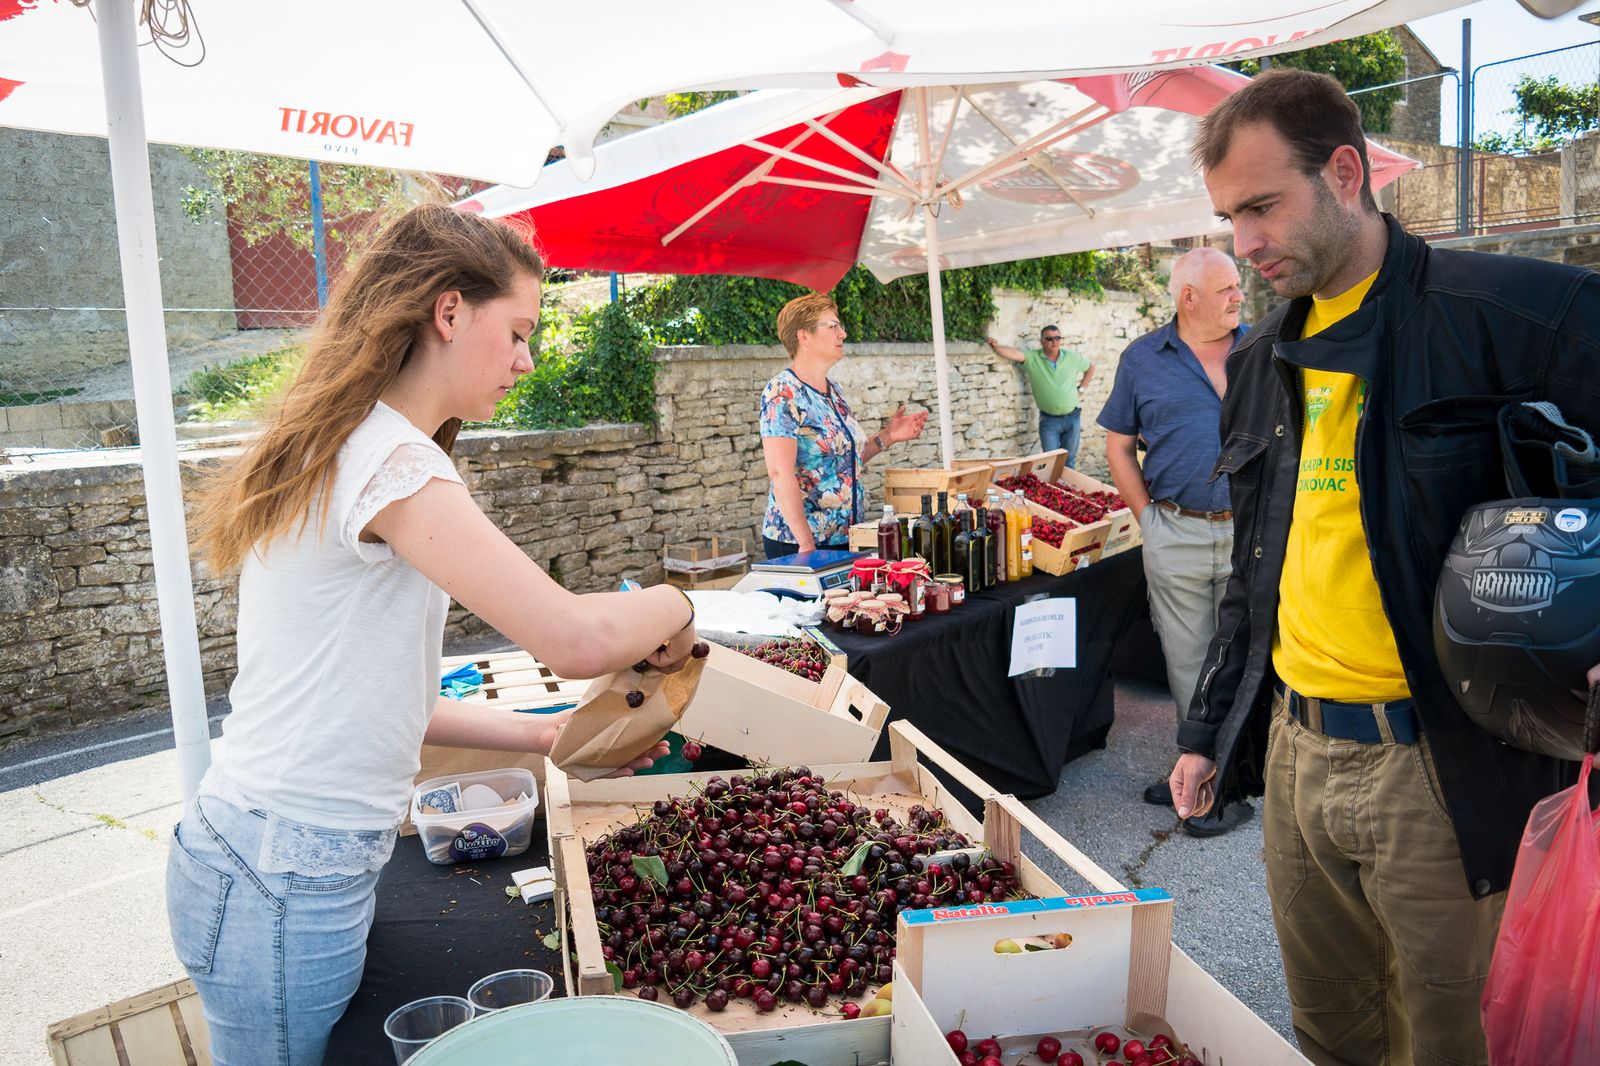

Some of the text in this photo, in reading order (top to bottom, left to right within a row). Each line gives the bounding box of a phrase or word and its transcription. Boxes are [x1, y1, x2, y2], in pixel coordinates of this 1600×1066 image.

[455, 834, 501, 852] Quattro
[1065, 892, 1140, 907] Natalia
[933, 905, 1009, 921] Natalia
